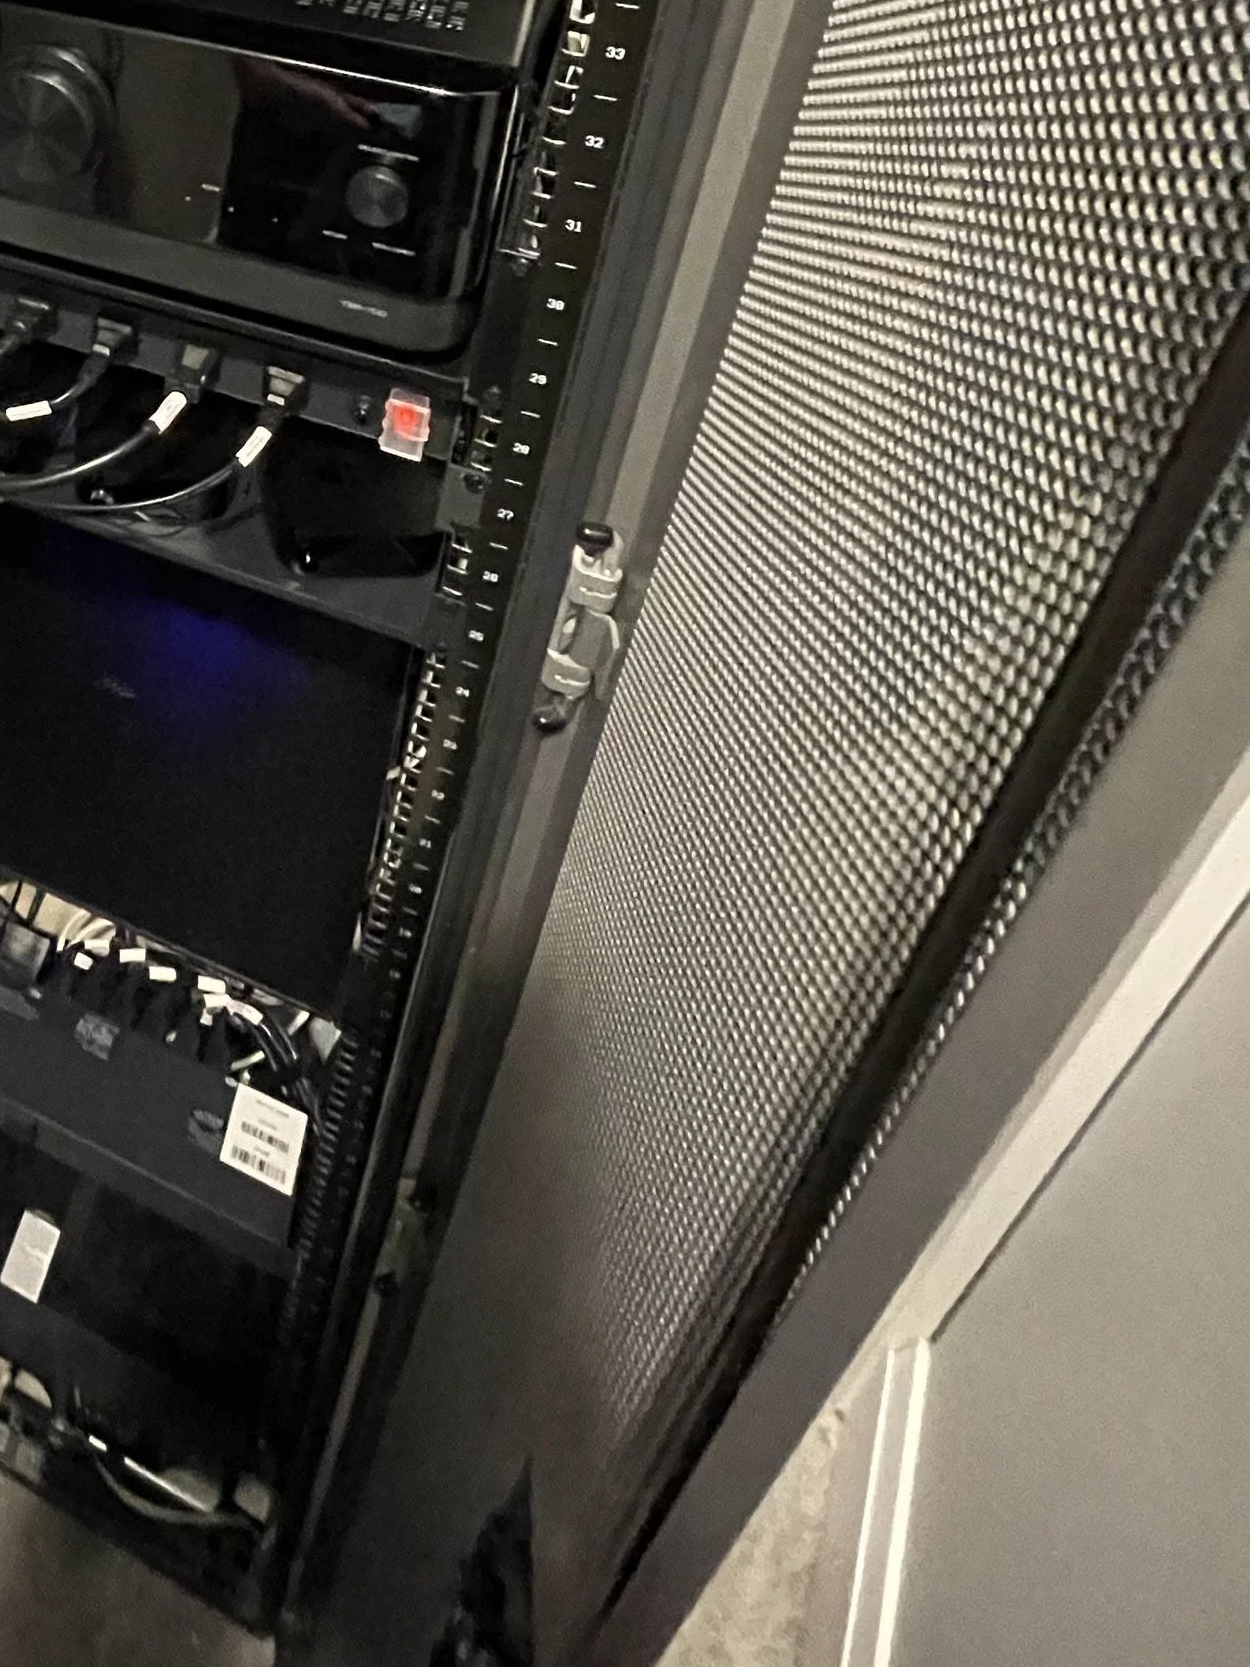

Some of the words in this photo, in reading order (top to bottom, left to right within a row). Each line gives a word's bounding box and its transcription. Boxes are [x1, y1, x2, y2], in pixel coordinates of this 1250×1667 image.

[605, 46, 626, 60] 33
[584, 135, 604, 149] 32
[565, 219, 582, 233] 31
[546, 298, 565, 311] 30
[529, 372, 547, 385] 29
[497, 508, 514, 520] 27
